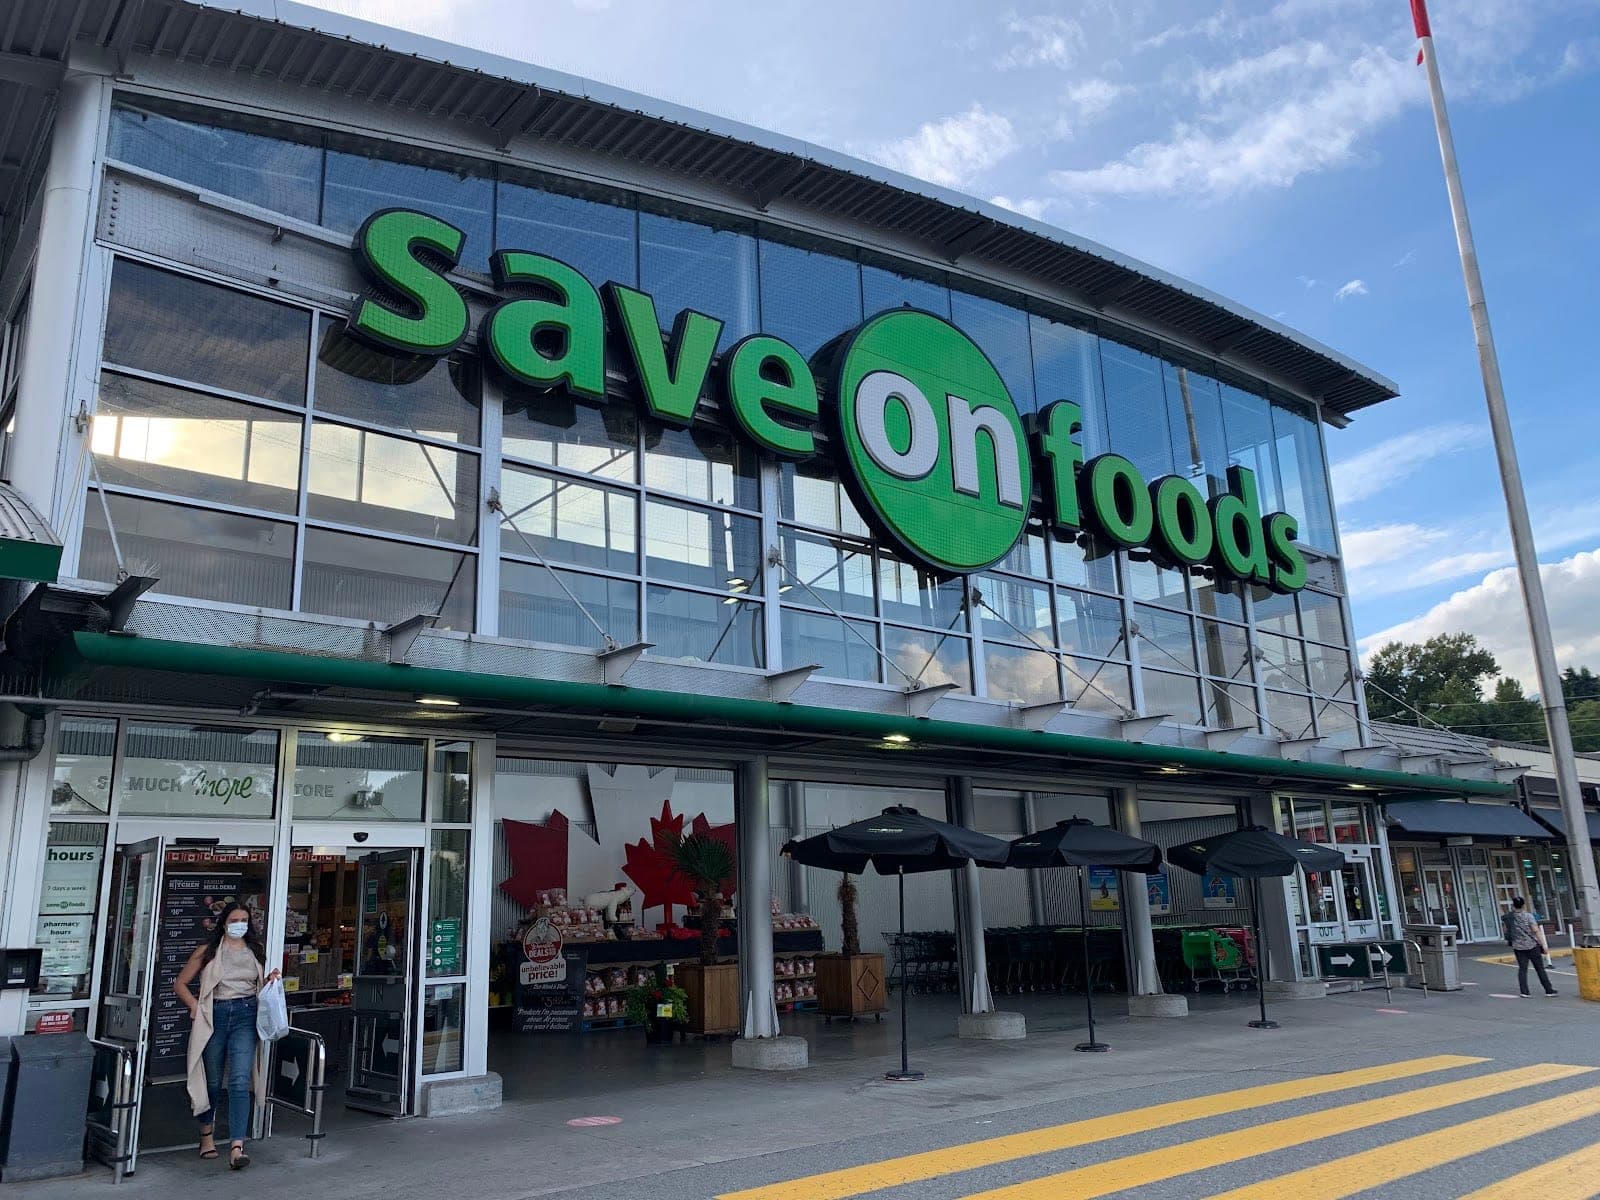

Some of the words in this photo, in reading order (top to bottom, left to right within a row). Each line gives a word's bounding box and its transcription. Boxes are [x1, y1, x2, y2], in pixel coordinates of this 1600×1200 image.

[347, 207, 820, 462] save
[854, 370, 1025, 512] on
[1040, 399, 1308, 594] foods
[129, 776, 182, 793] MUCH
[294, 783, 335, 798] TORE
[48, 848, 94, 861] hours
[1319, 927, 1334, 937] OUT
[1360, 924, 1367, 935] IN
[521, 962, 565, 973] unbelievable
[528, 970, 558, 982] price!
